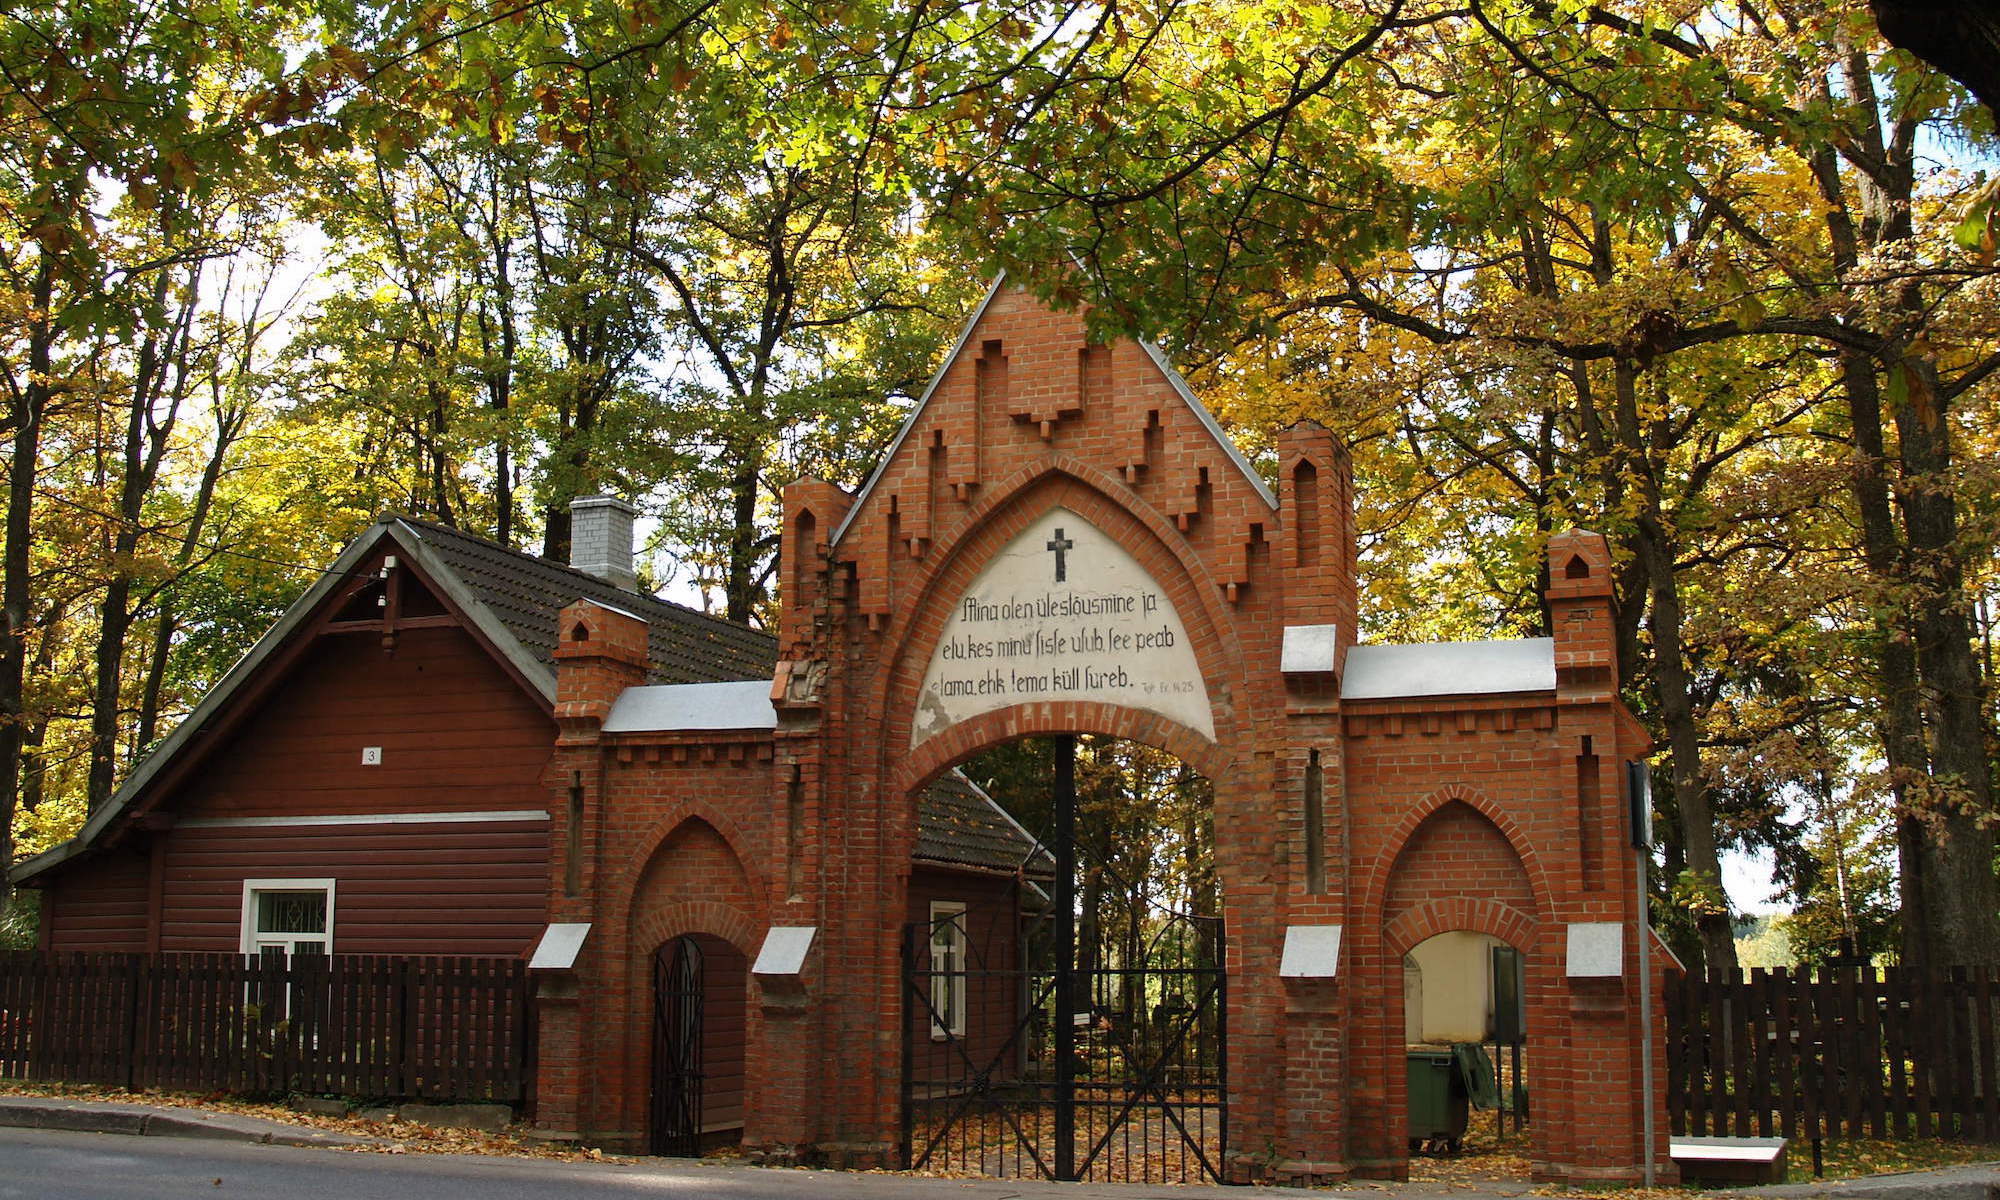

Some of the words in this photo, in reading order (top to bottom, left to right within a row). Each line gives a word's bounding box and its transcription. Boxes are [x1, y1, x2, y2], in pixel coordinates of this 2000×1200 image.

[1002, 594, 1033, 620] olen
[1142, 592, 1157, 619] ja
[968, 634, 993, 658] kes
[997, 637, 1032, 657] minu
[1135, 625, 1174, 653] peab
[978, 668, 1005, 694] ehk
[1052, 666, 1079, 692] küll
[368, 750, 375, 762] 3
